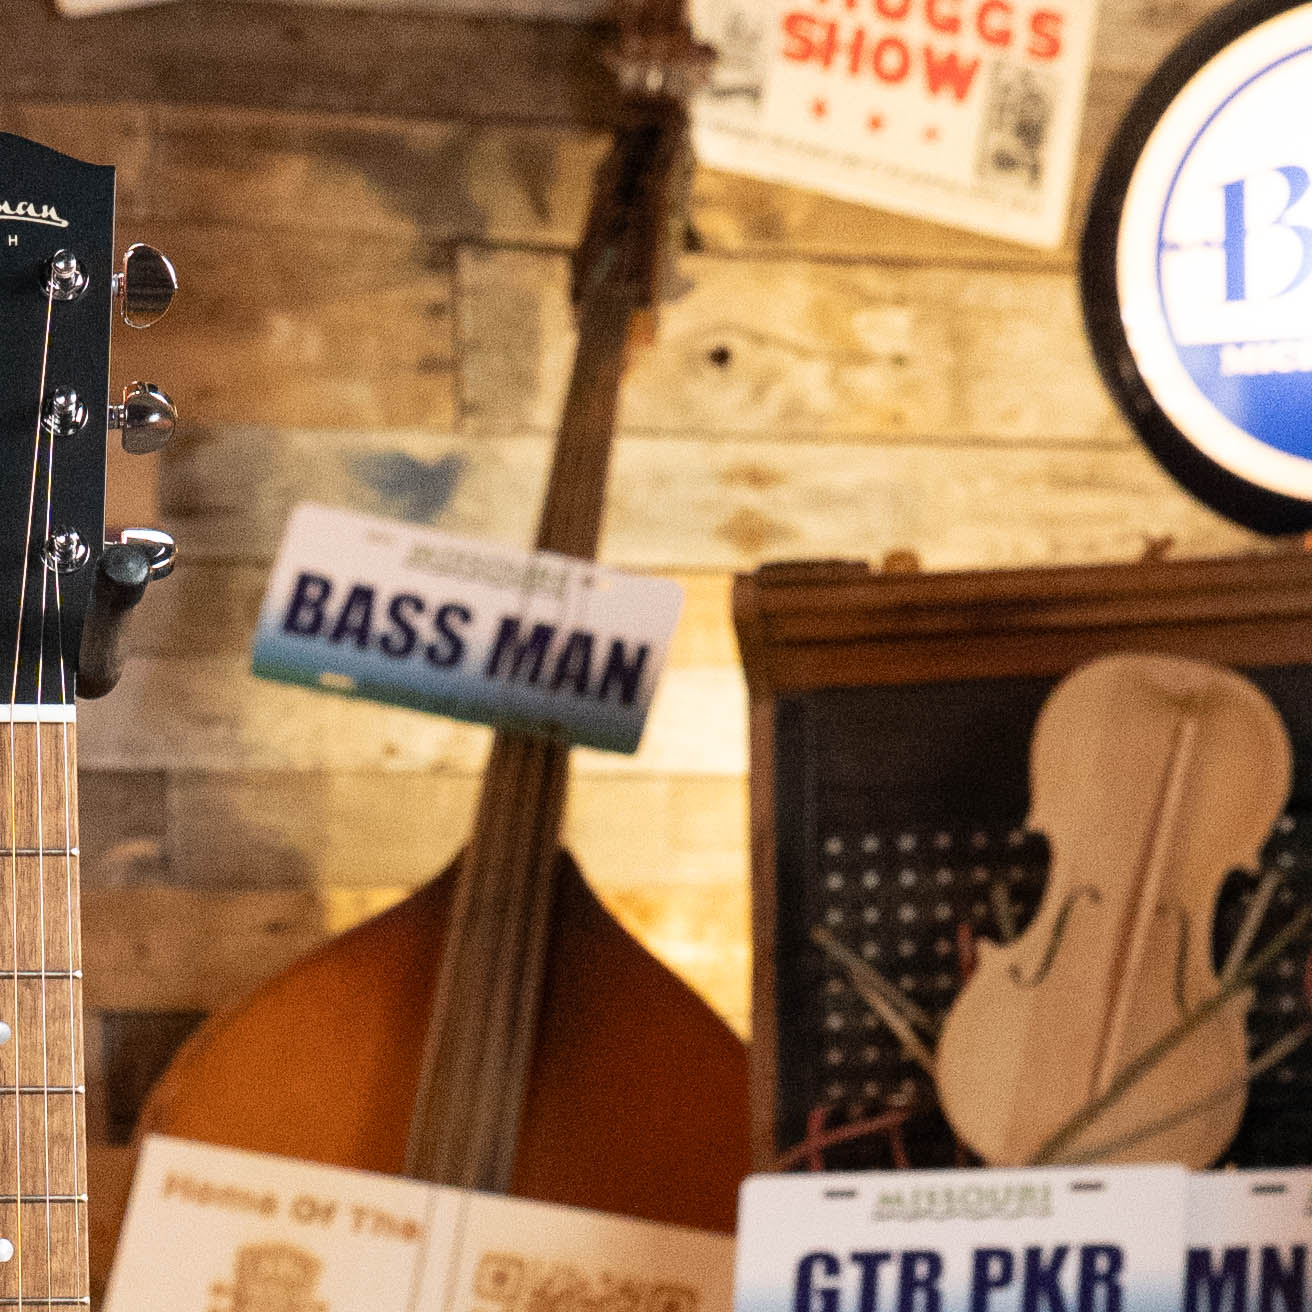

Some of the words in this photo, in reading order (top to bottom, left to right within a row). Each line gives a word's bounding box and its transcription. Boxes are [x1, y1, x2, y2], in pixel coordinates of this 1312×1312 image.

[782, 12, 979, 102] SHOW
[283, 570, 472, 667] BASS
[487, 616, 649, 707] MAN
